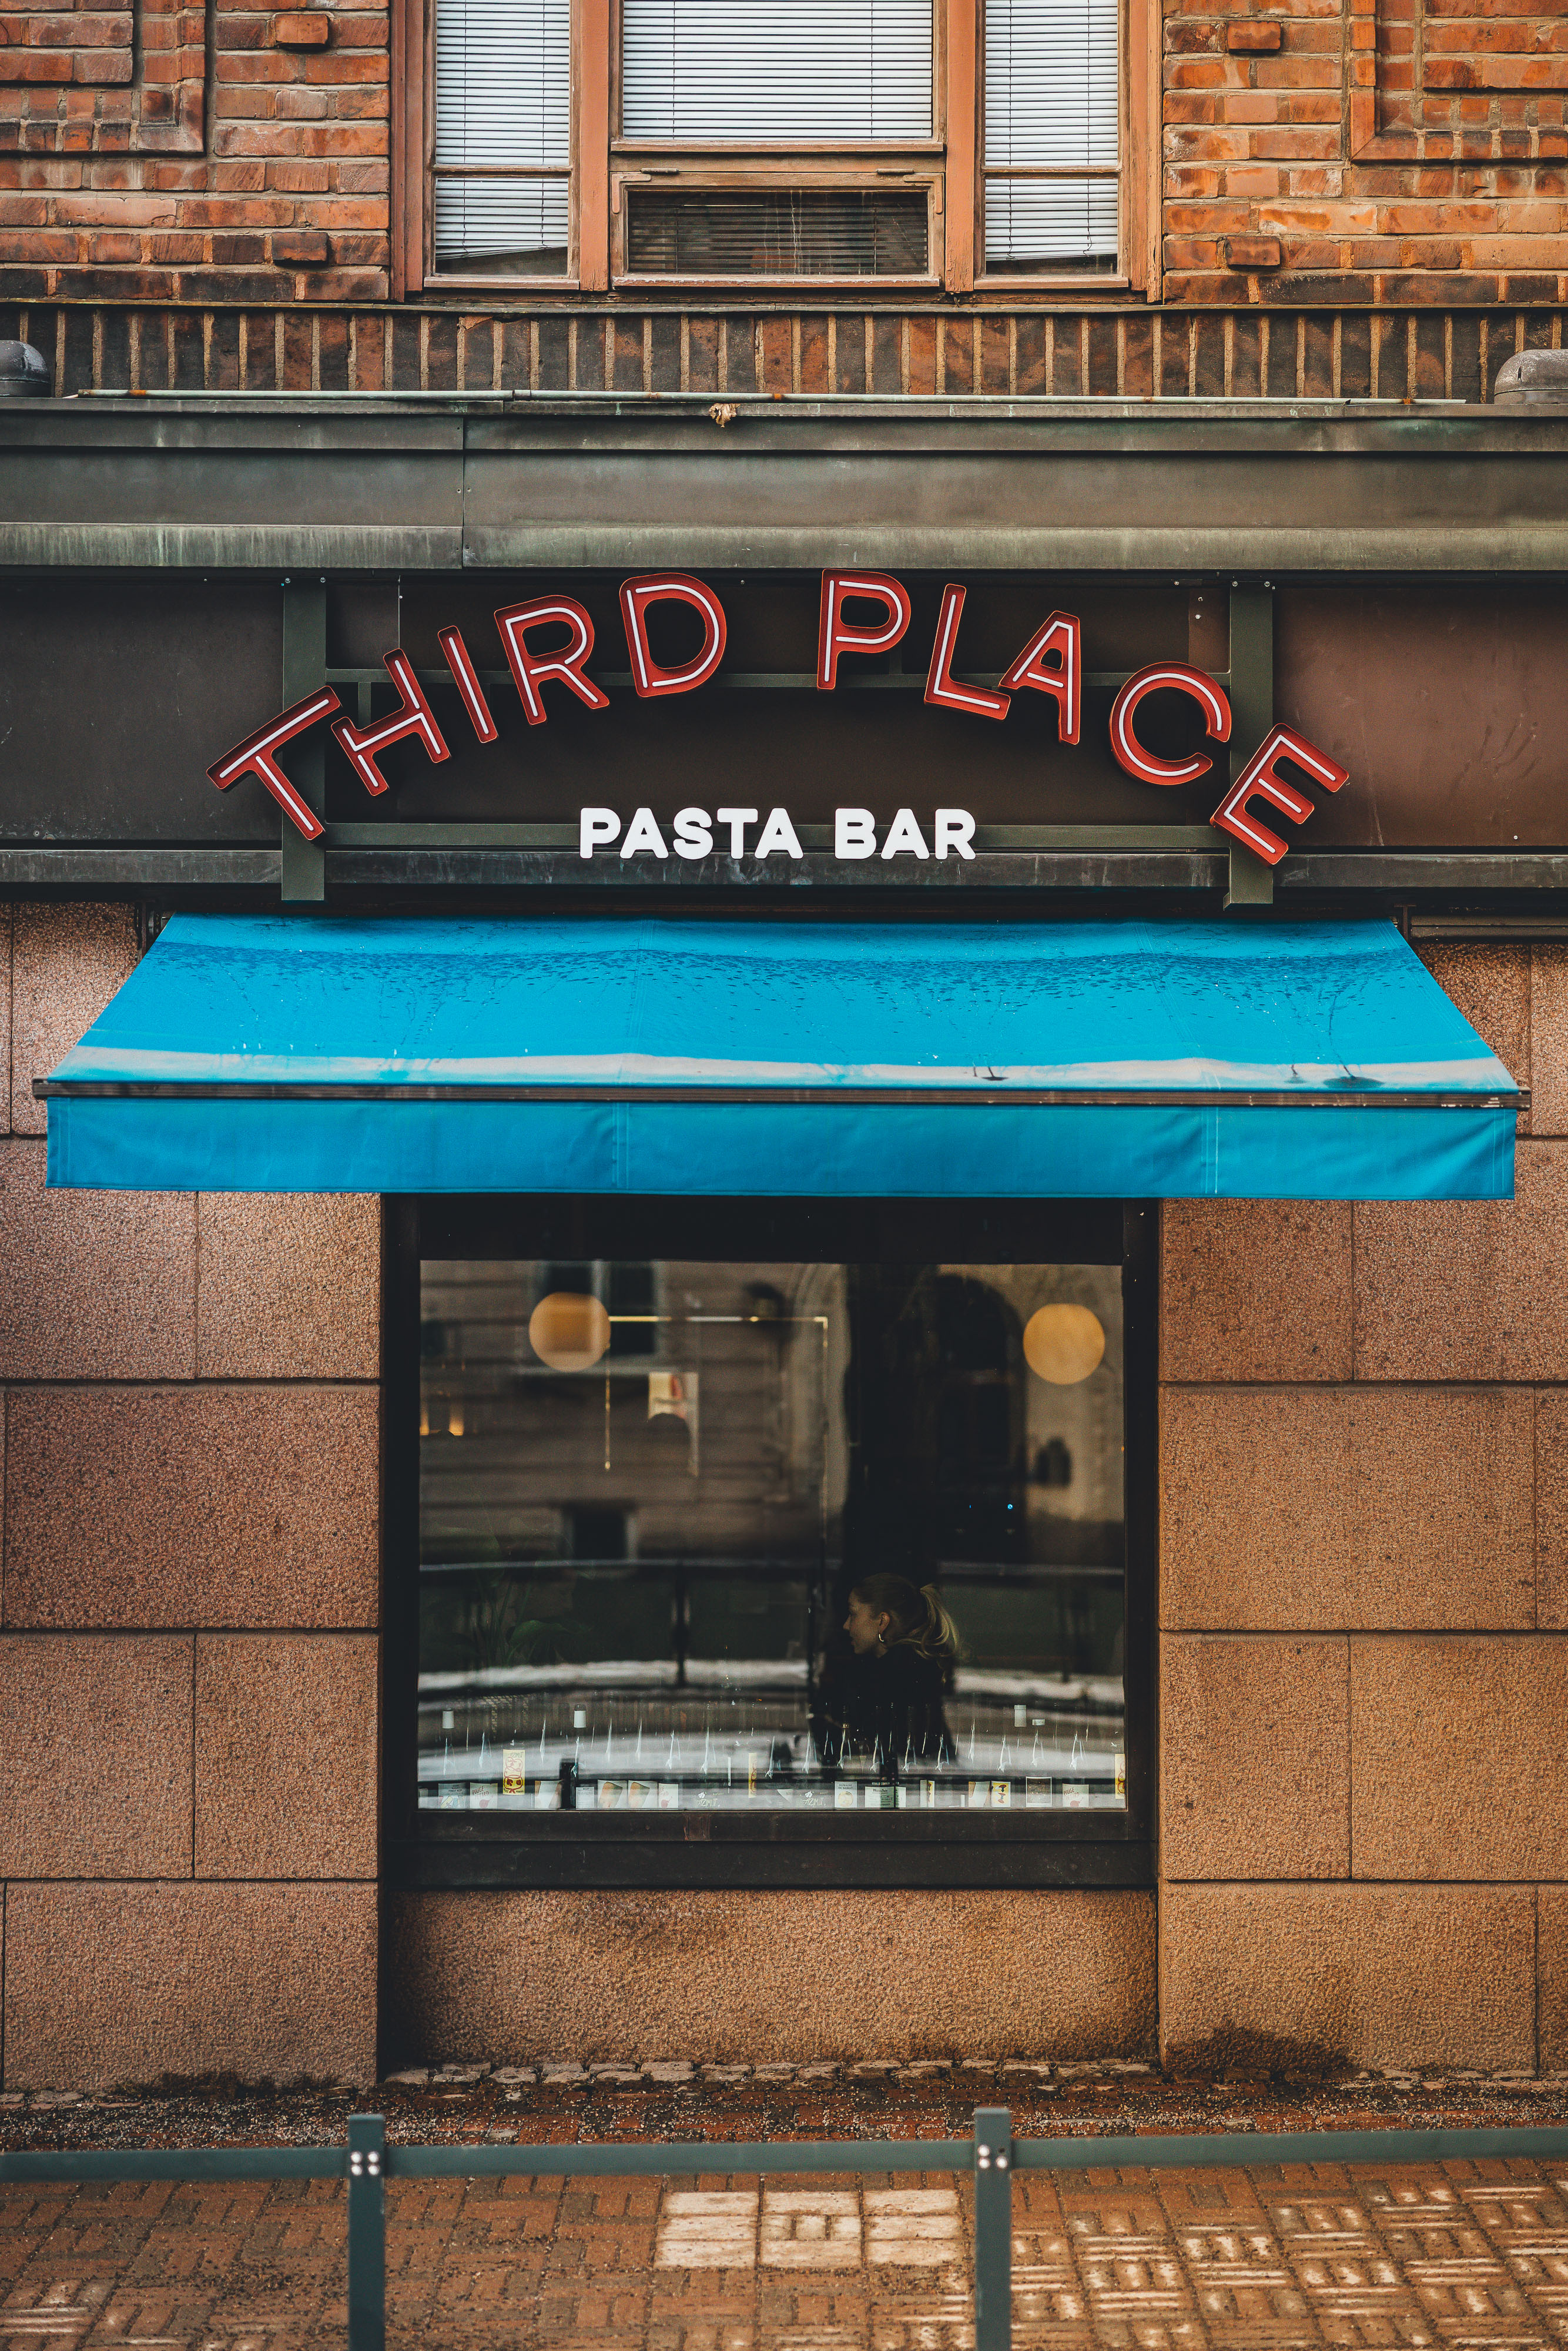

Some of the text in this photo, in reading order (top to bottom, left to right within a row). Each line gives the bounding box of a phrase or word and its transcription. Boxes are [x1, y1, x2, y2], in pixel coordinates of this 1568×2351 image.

[206, 568, 1349, 868] THIRD PLACE
[579, 807, 976, 860] PASTA BAR
